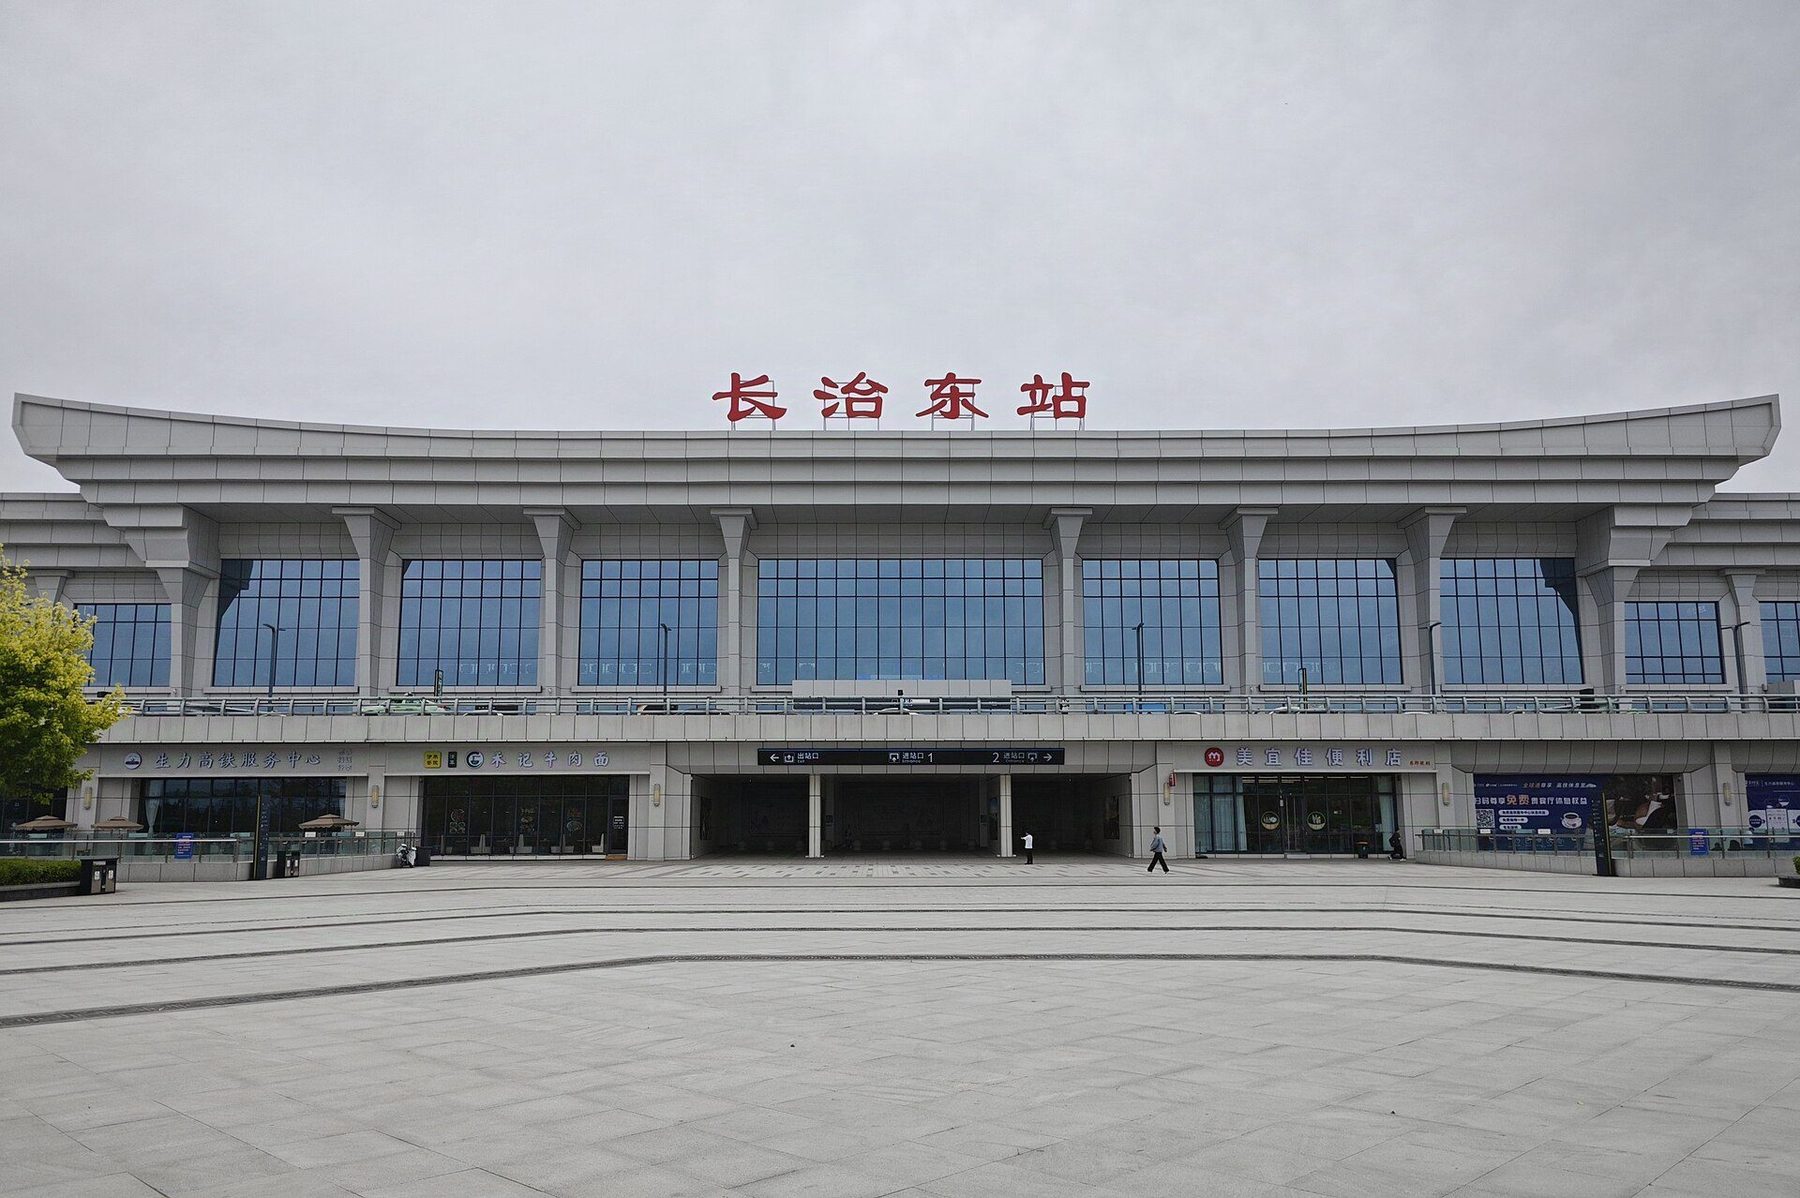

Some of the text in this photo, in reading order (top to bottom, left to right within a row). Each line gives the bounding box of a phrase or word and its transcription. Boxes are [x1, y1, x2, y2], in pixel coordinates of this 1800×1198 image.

[712, 371, 1091, 422] 长治东站
[154, 751, 321, 769] 生力高铁服务中心
[797, 752, 819, 760] 出站口
[902, 752, 933, 763] 进站口 1
[992, 752, 1025, 763] 2 进站口
[1236, 747, 1402, 767] 美宜佳便利店
